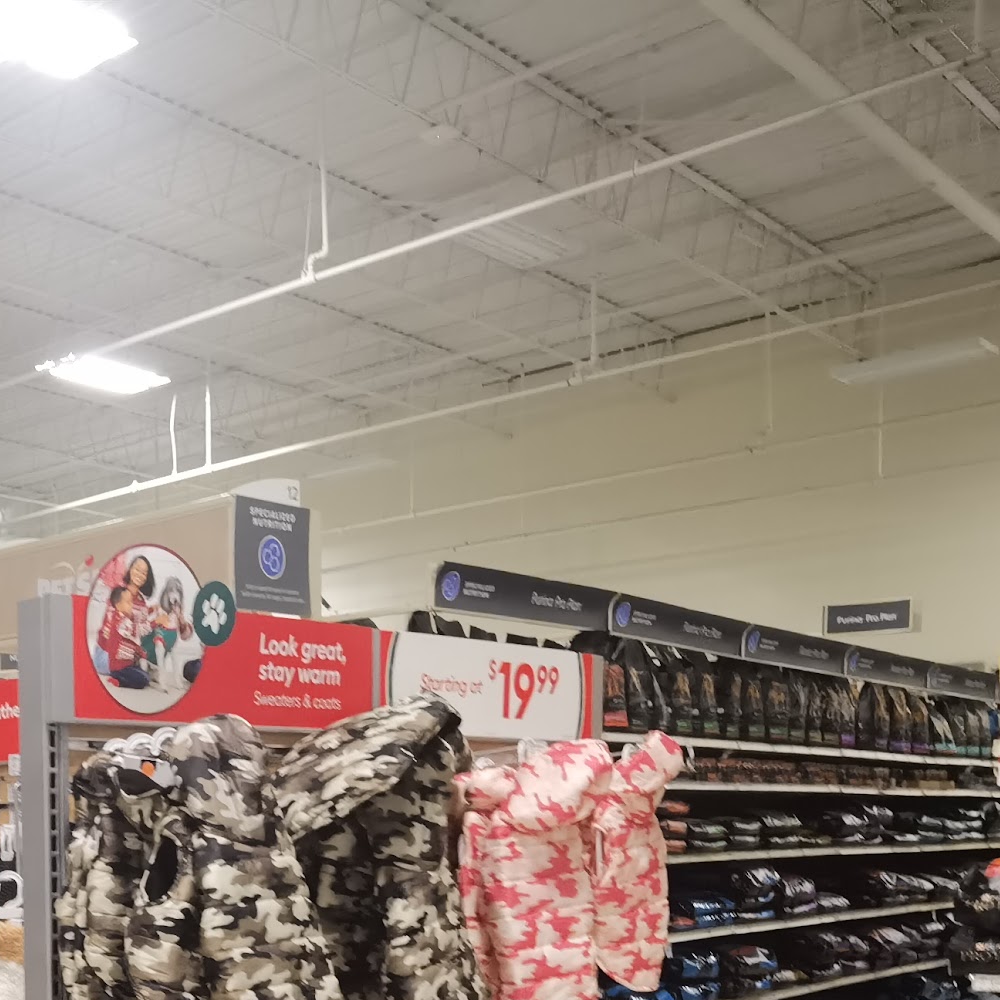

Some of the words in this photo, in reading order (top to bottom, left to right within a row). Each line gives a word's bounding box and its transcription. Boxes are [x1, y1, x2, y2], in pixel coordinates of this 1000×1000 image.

[260, 632, 299, 657] Look
[300, 642, 347, 666] great,
[258, 661, 296, 688] stay
[297, 667, 341, 686] warm
[420, 673, 467, 698] Starting
[470, 680, 483, 694] at
[253, 690, 301, 708] Sweaters
[302, 693, 312, 708] &
[312, 697, 342, 710] coats
